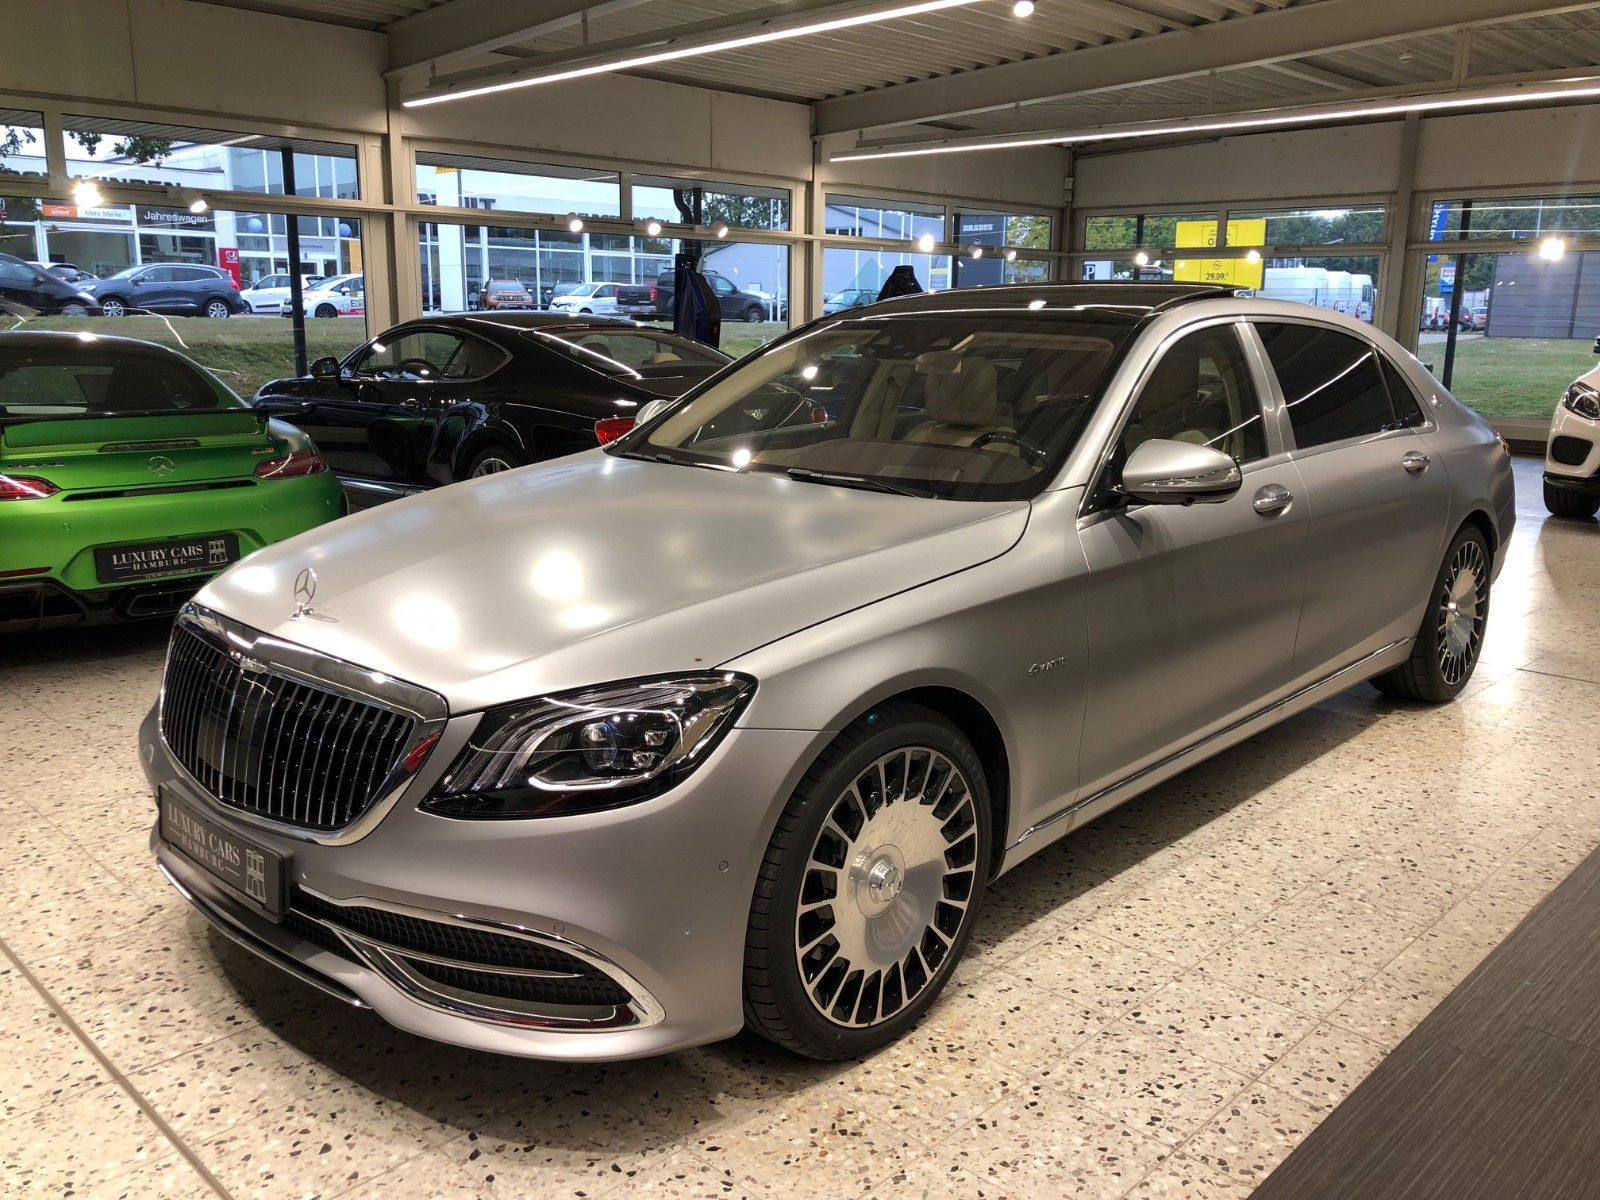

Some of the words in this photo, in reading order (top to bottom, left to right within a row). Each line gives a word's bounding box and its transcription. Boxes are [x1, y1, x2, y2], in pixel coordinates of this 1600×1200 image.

[144, 212, 208, 225] Jahreswagen
[962, 223, 993, 232] BRABUS
[1085, 265, 1095, 280] P
[112, 549, 168, 565] LUXURY
[170, 544, 204, 558] CARS
[132, 559, 187, 571] HAMBURG
[168, 803, 207, 846] LUXURY
[209, 833, 241, 866] CARS
[181, 833, 225, 871] HAMBURG
